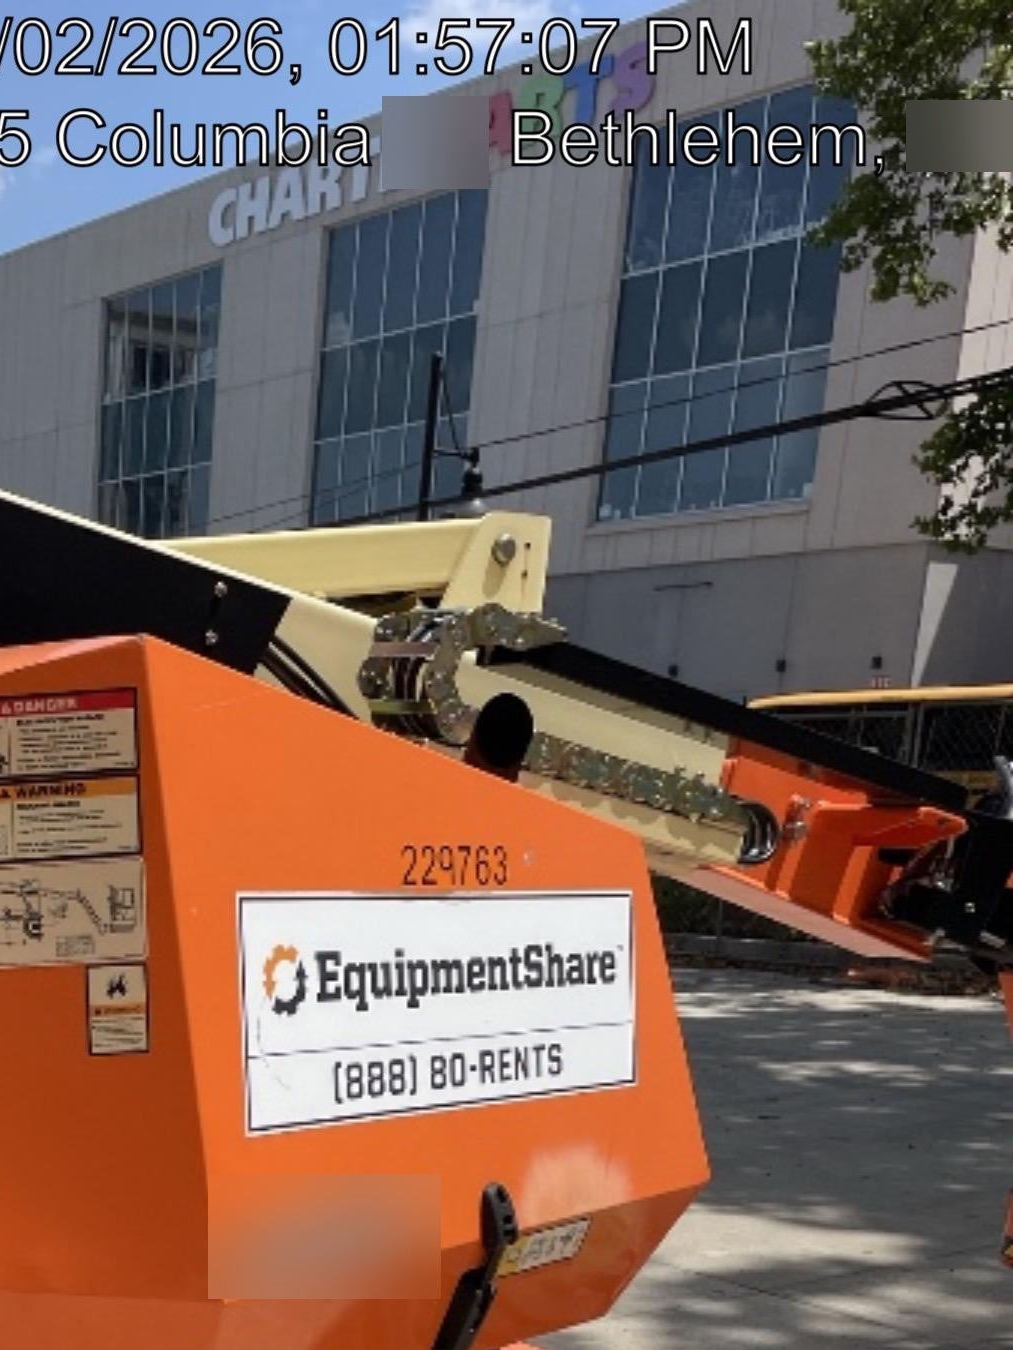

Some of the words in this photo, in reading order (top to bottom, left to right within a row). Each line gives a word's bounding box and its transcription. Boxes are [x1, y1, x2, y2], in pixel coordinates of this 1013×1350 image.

[208, 137, 384, 247] CHART
[400, 845, 508, 886] 229763
[314, 944, 617, 1012] EquipmentShare
[333, 1054, 417, 1104] (888)
[429, 1043, 564, 1091] 80-RENTS
